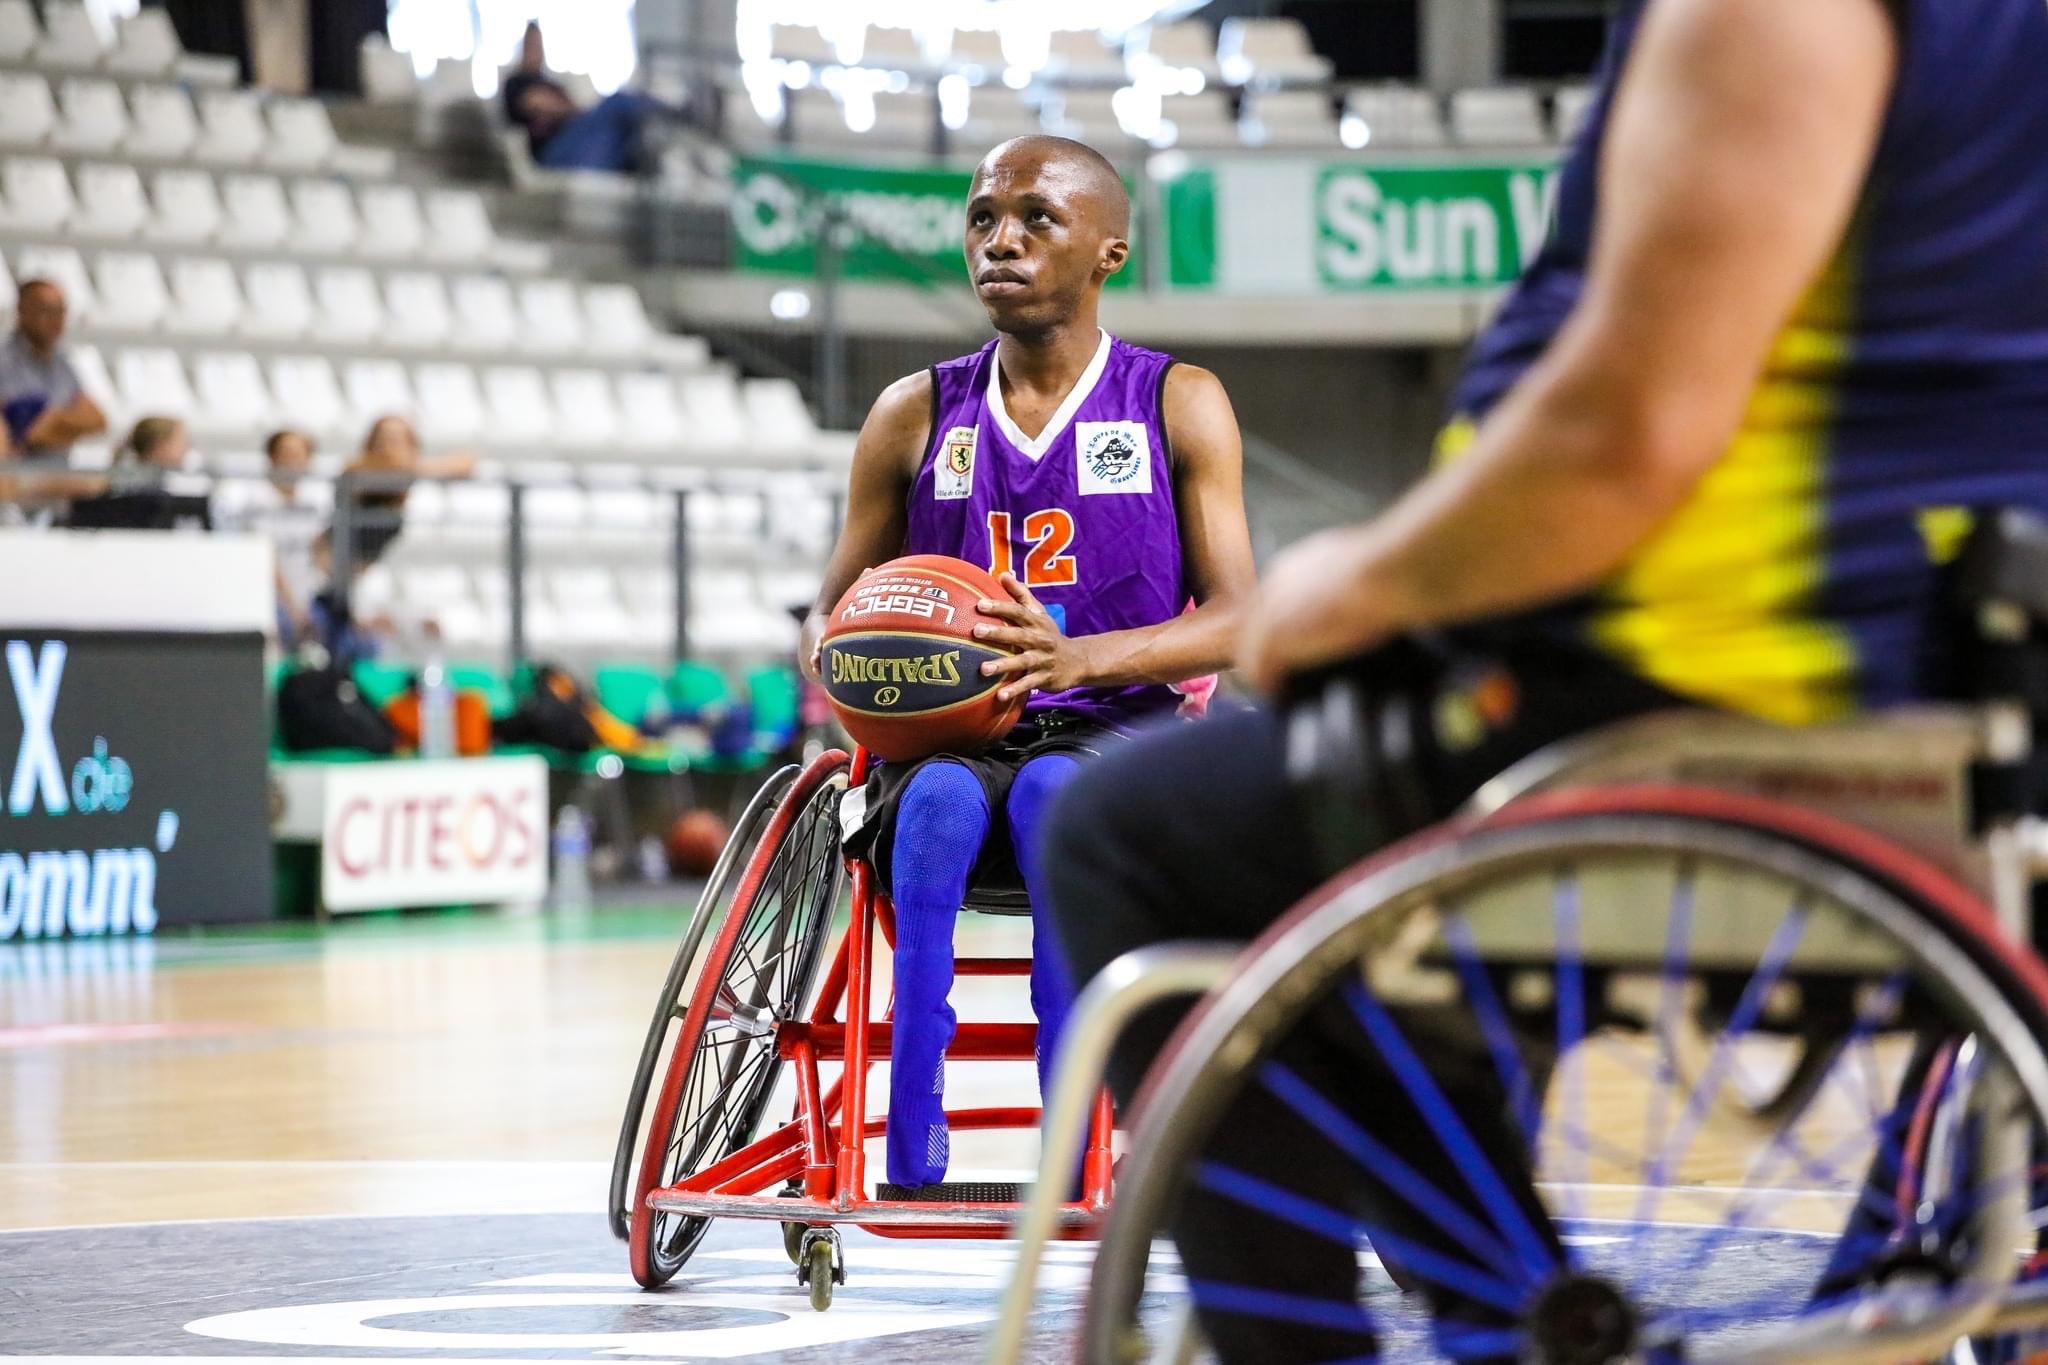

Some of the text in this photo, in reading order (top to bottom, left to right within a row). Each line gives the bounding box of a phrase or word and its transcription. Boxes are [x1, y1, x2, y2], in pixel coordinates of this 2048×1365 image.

[1322, 172, 1499, 279] Sun
[988, 508, 1078, 588] 12
[841, 594, 956, 625] LEGACY
[855, 584, 921, 599] 1000
[831, 648, 961, 687] SPALDING
[332, 788, 536, 880] CITEOS
